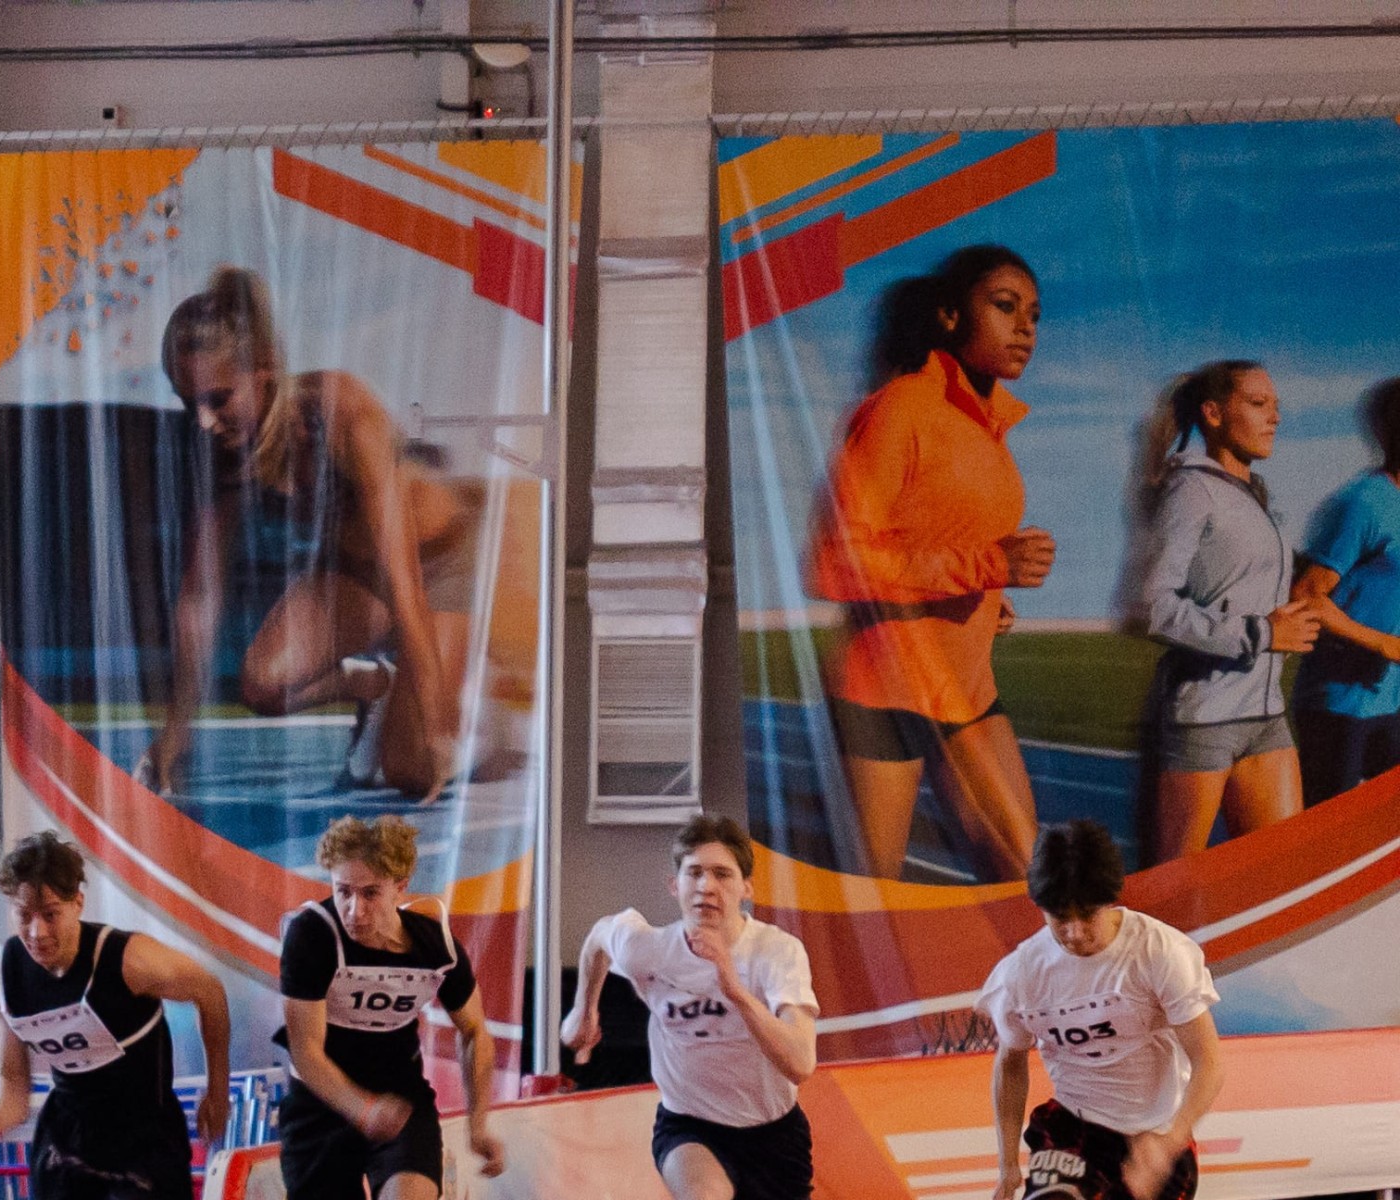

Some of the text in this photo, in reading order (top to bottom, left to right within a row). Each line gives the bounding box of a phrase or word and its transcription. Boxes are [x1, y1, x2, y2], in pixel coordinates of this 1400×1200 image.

[350, 991, 417, 1012] 105
[667, 998, 727, 1019] 104
[1048, 1020, 1117, 1046] 103
